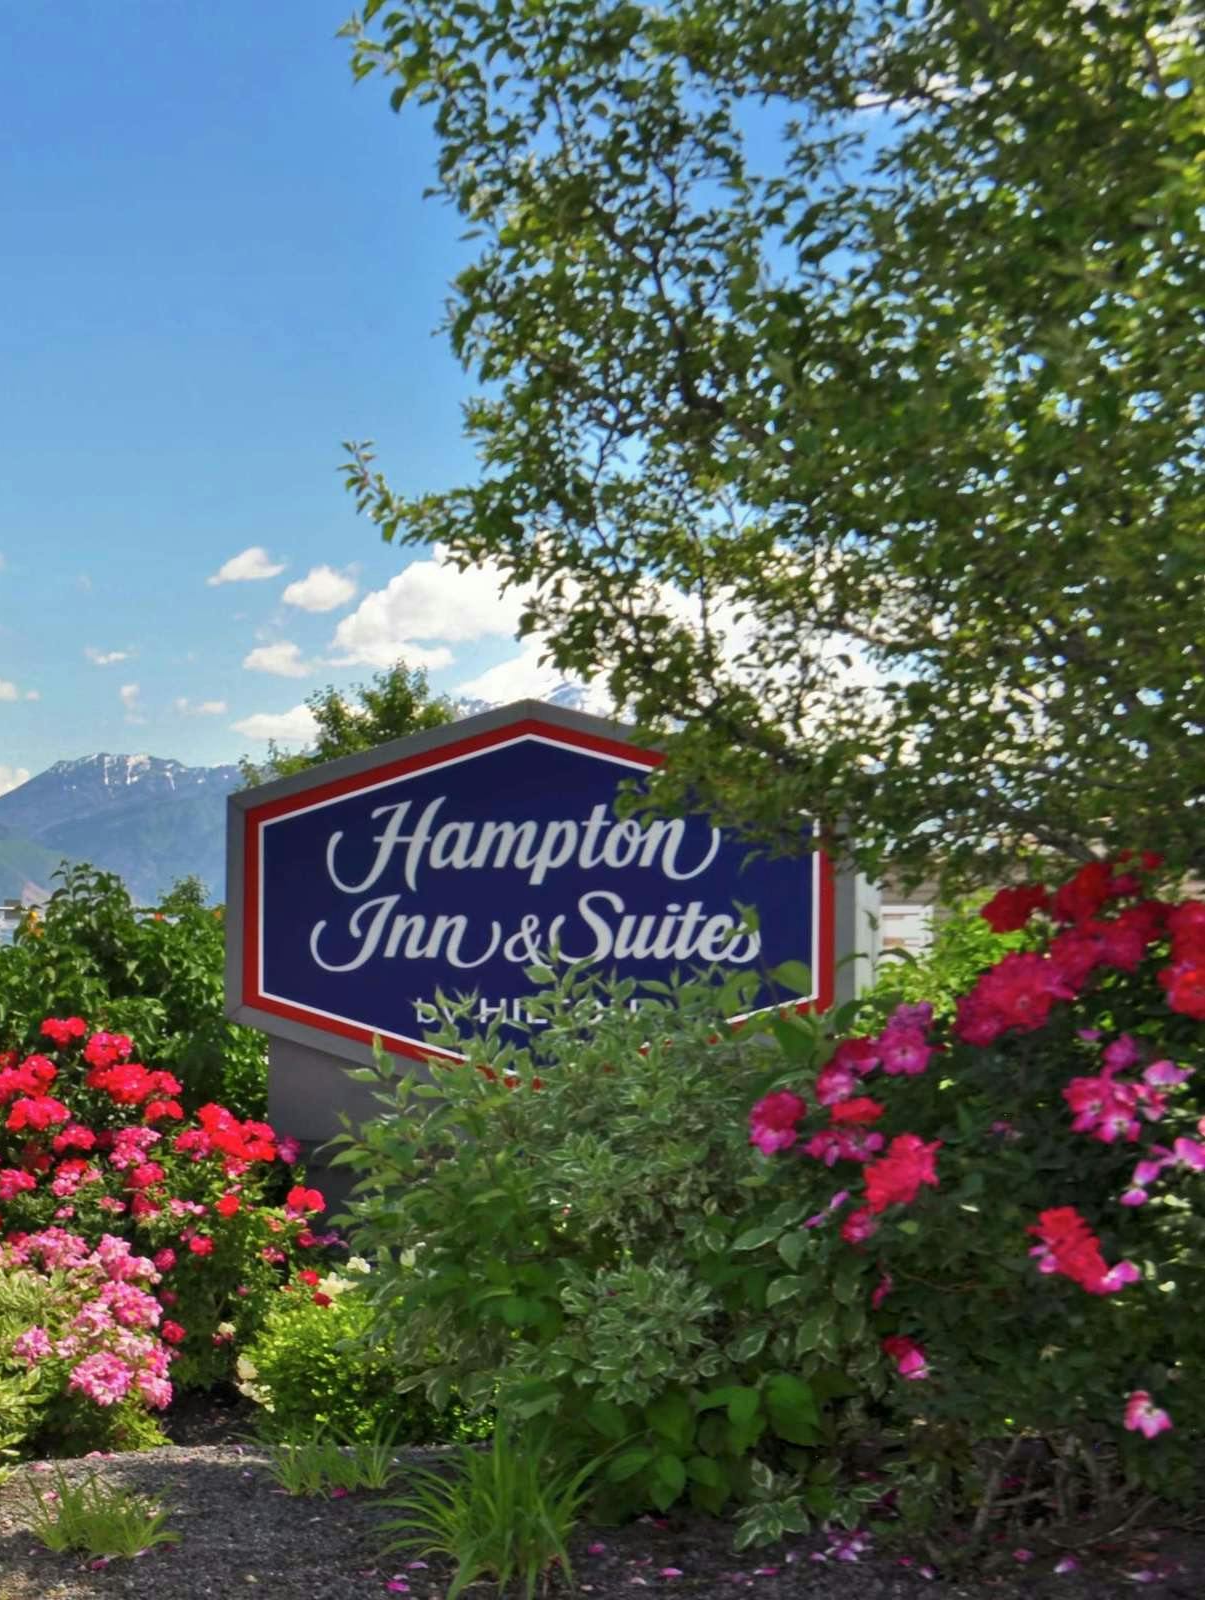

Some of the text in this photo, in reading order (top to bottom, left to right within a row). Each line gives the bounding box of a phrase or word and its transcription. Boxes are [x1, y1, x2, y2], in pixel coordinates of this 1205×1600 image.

[326, 796, 720, 894] Hampton
[310, 890, 761, 972] Inn & Suites
